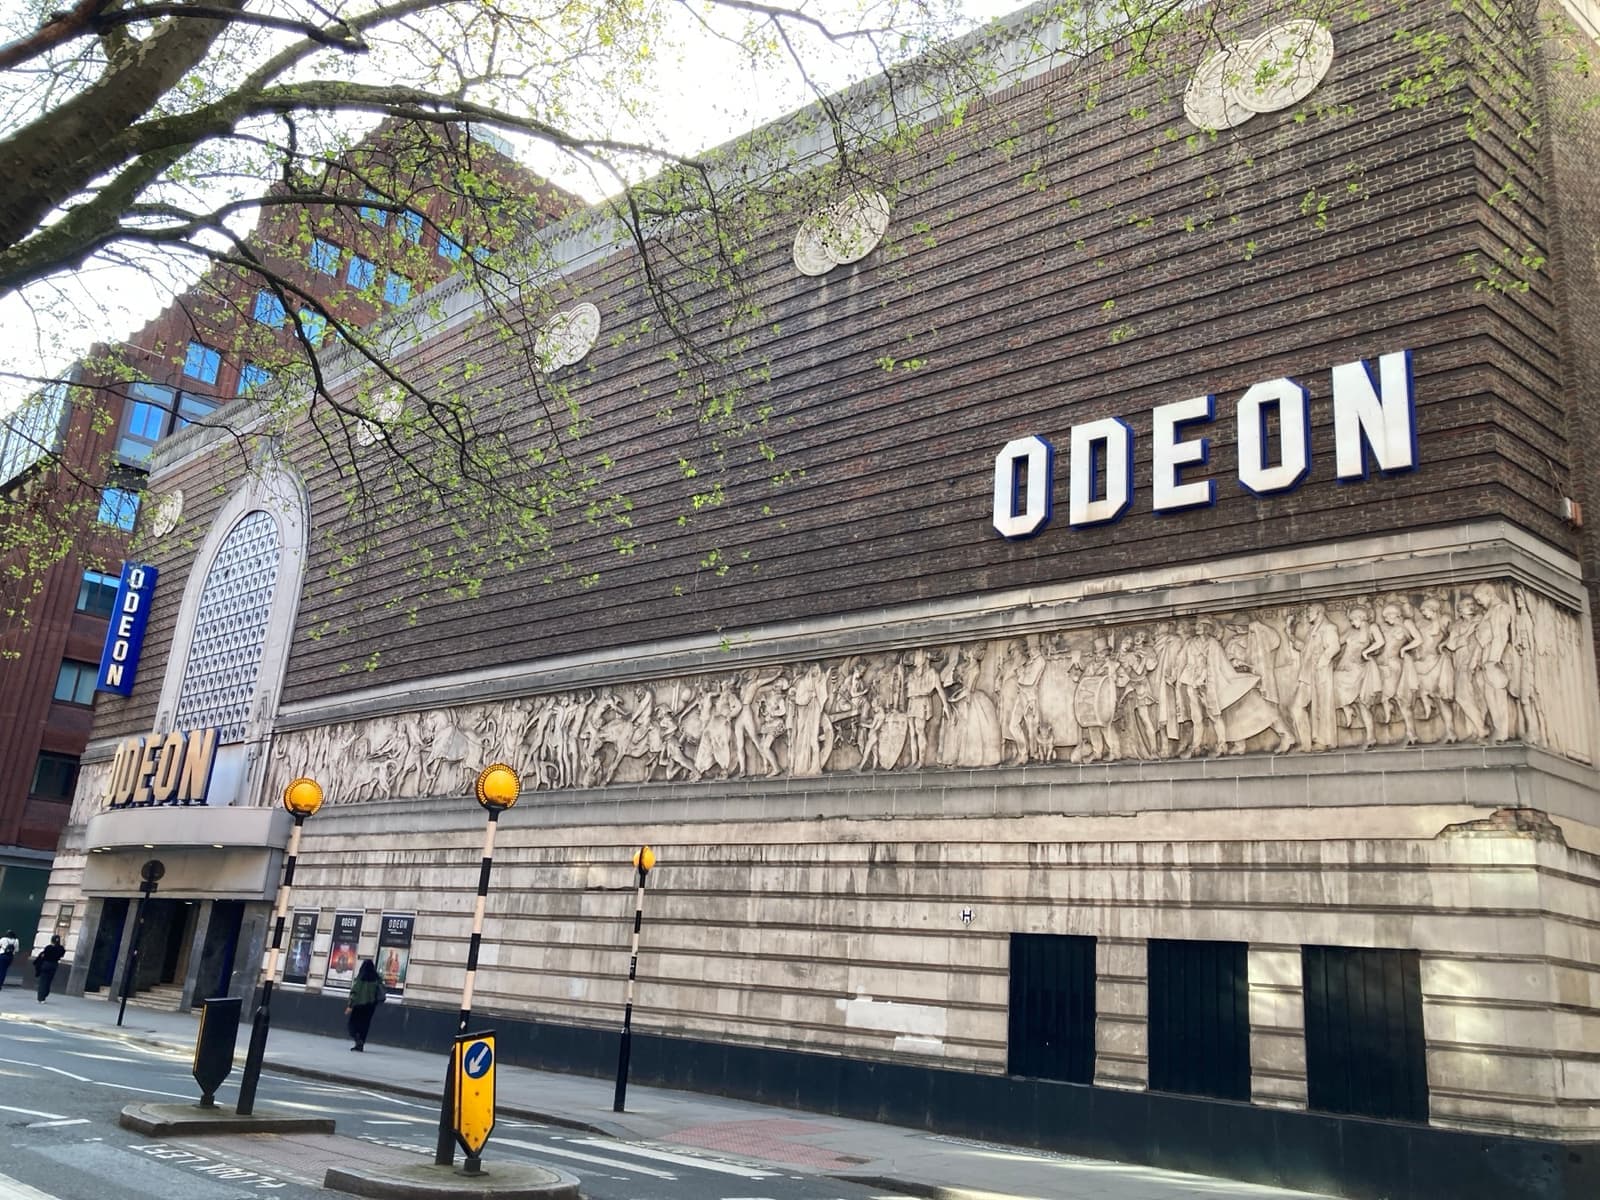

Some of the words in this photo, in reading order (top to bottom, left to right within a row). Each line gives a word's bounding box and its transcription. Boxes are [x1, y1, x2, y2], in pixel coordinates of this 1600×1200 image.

[992, 349, 1417, 541] ODEON
[105, 568, 145, 687] ODEON
[104, 728, 221, 808] ODEON
[341, 917, 357, 927] ODEON
[388, 919, 408, 929] ODEON
[127, 1144, 210, 1164] LEFT
